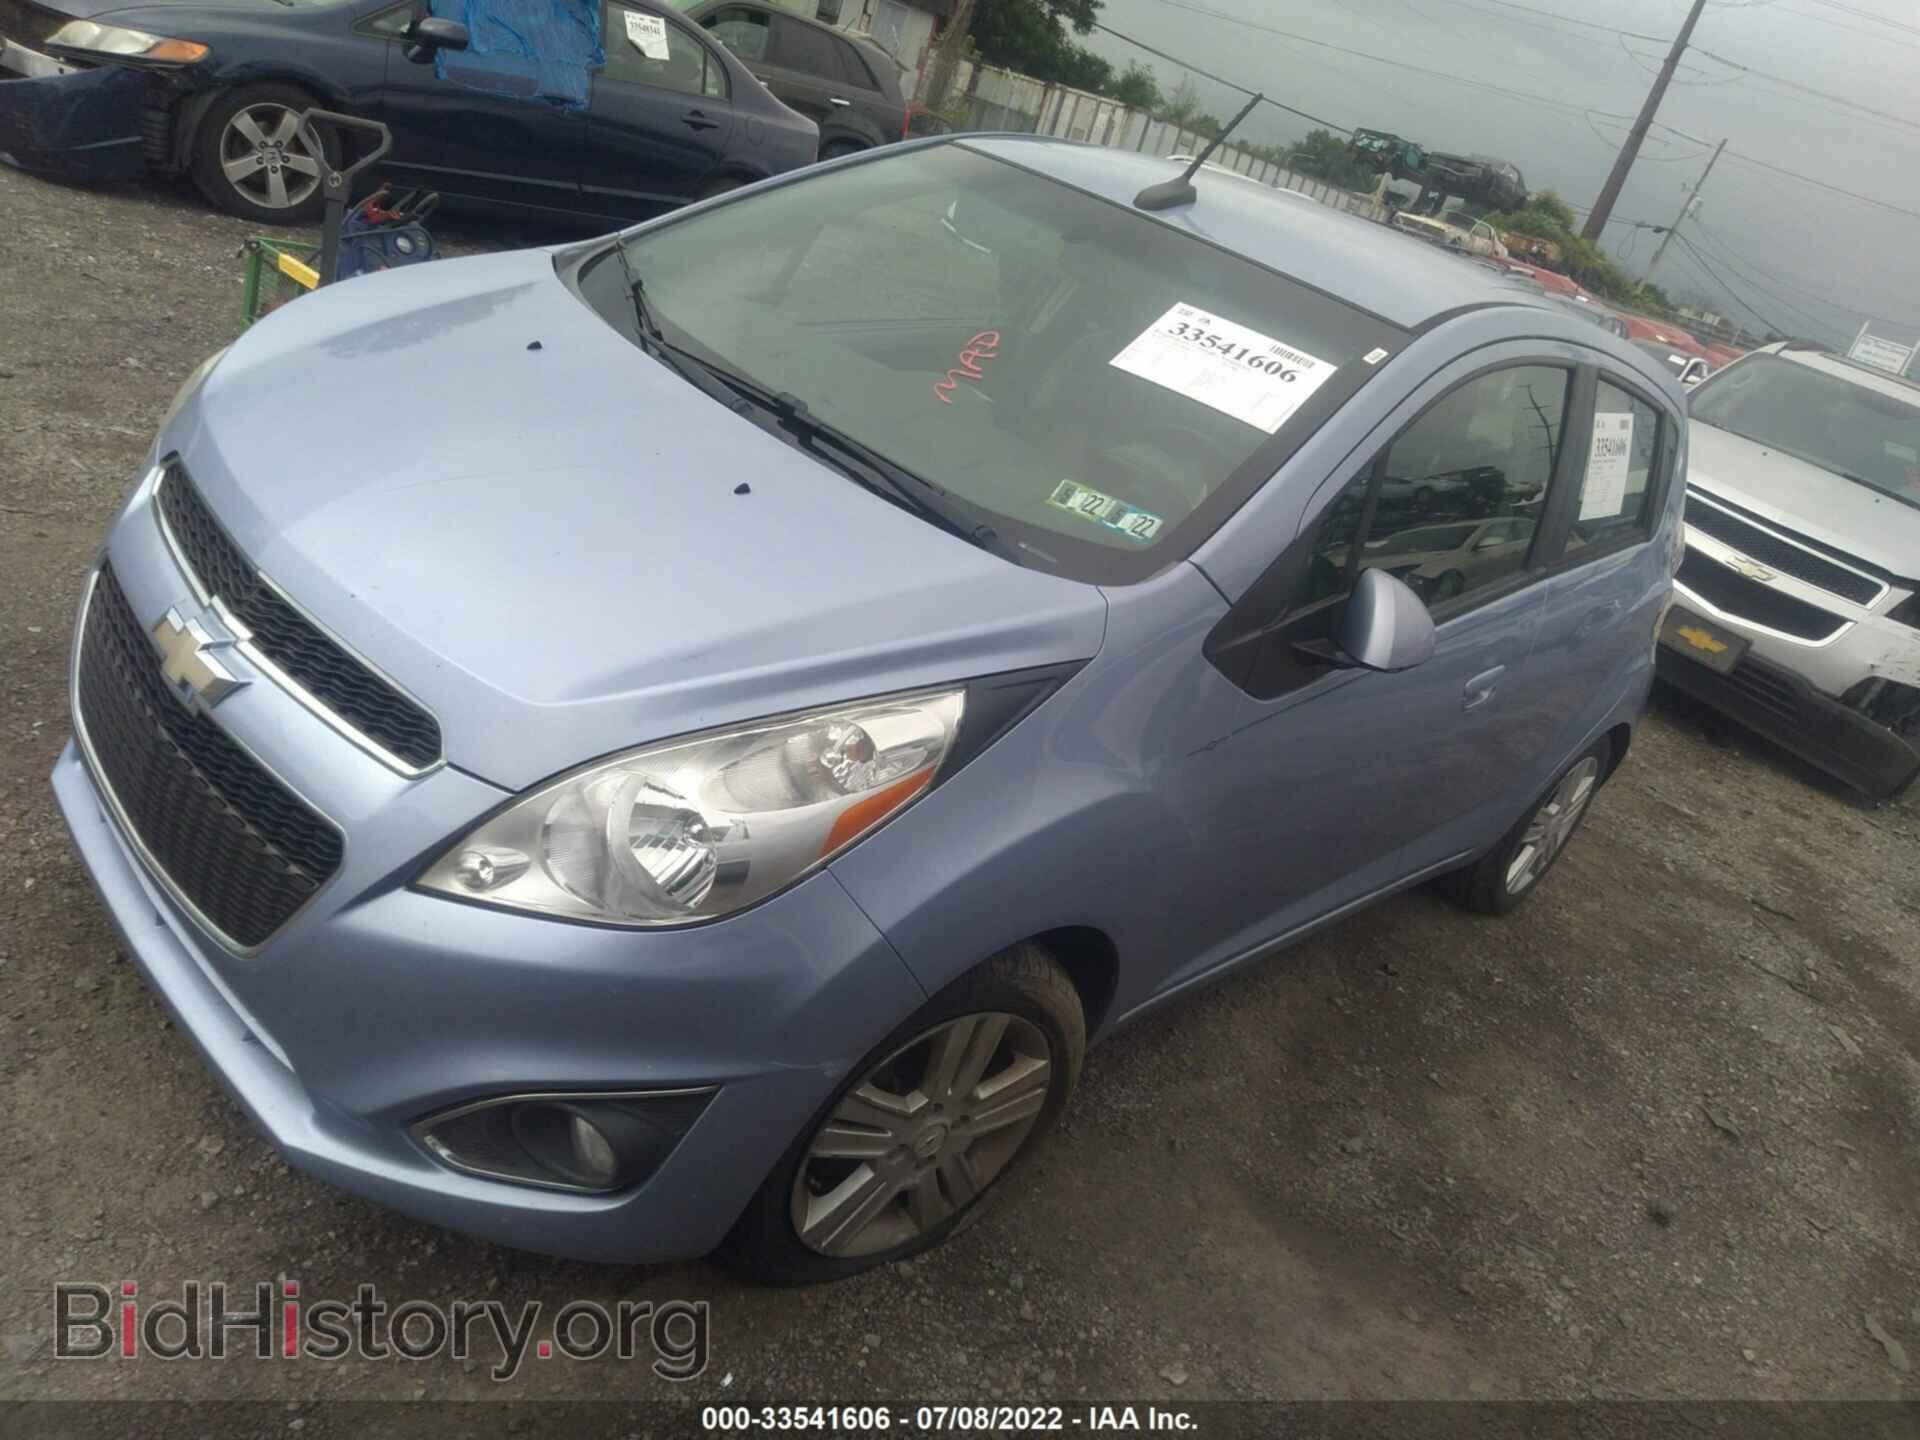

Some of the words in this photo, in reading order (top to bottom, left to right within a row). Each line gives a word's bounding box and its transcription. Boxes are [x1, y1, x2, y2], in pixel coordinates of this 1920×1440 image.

[1167, 321, 1298, 384] 33541606
[1081, 494, 1105, 515] 22
[1131, 515, 1155, 537] 22
